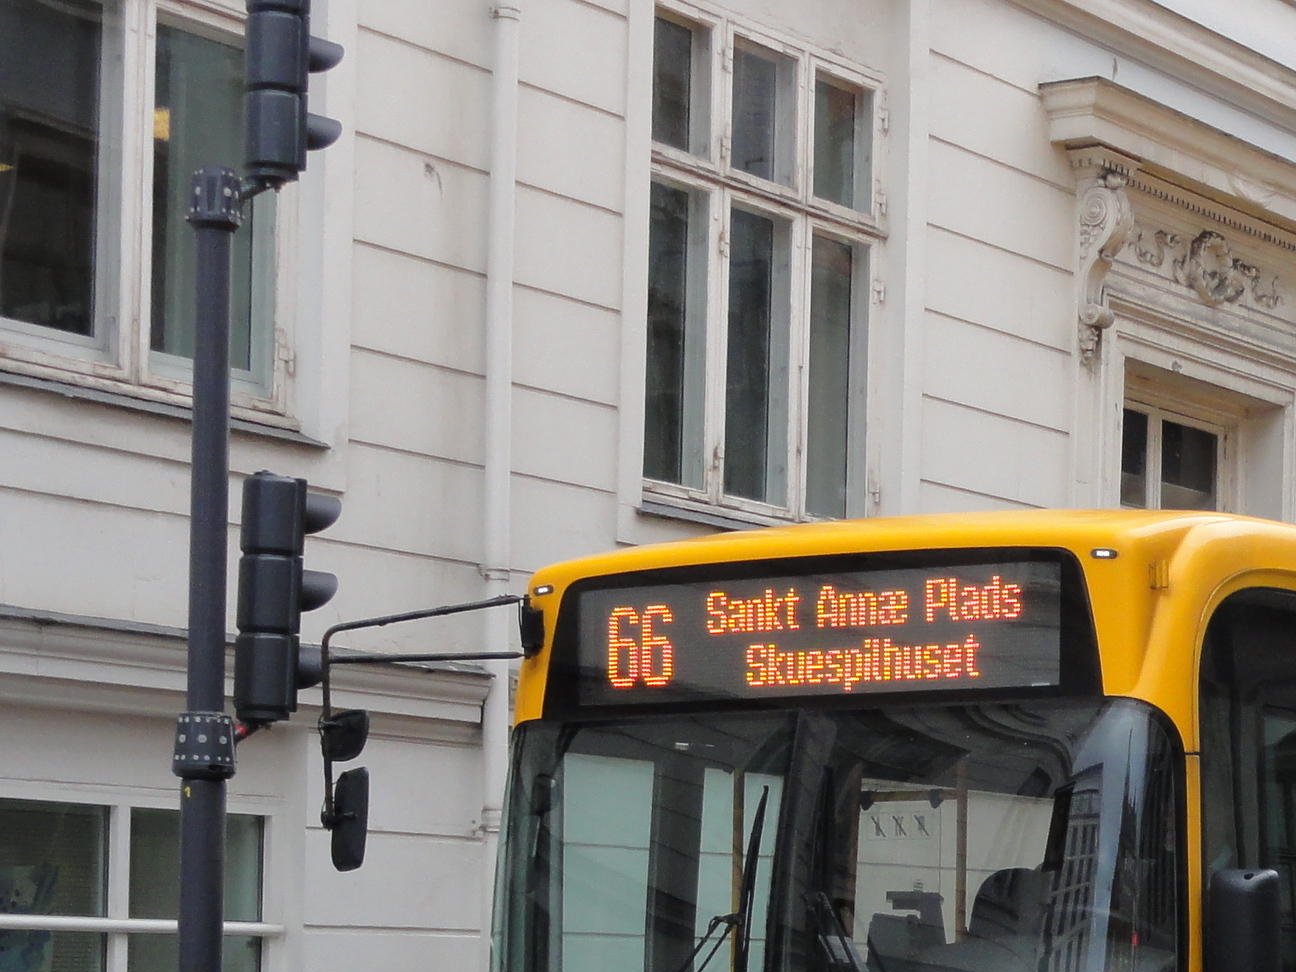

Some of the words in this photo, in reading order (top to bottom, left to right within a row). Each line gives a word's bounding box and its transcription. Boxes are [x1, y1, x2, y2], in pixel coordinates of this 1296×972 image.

[706, 588, 801, 634] Sankt
[816, 584, 908, 628] Annæ
[924, 575, 1022, 622] Plads
[607, 604, 674, 689] 66
[746, 634, 980, 691] Skuespilhuset
